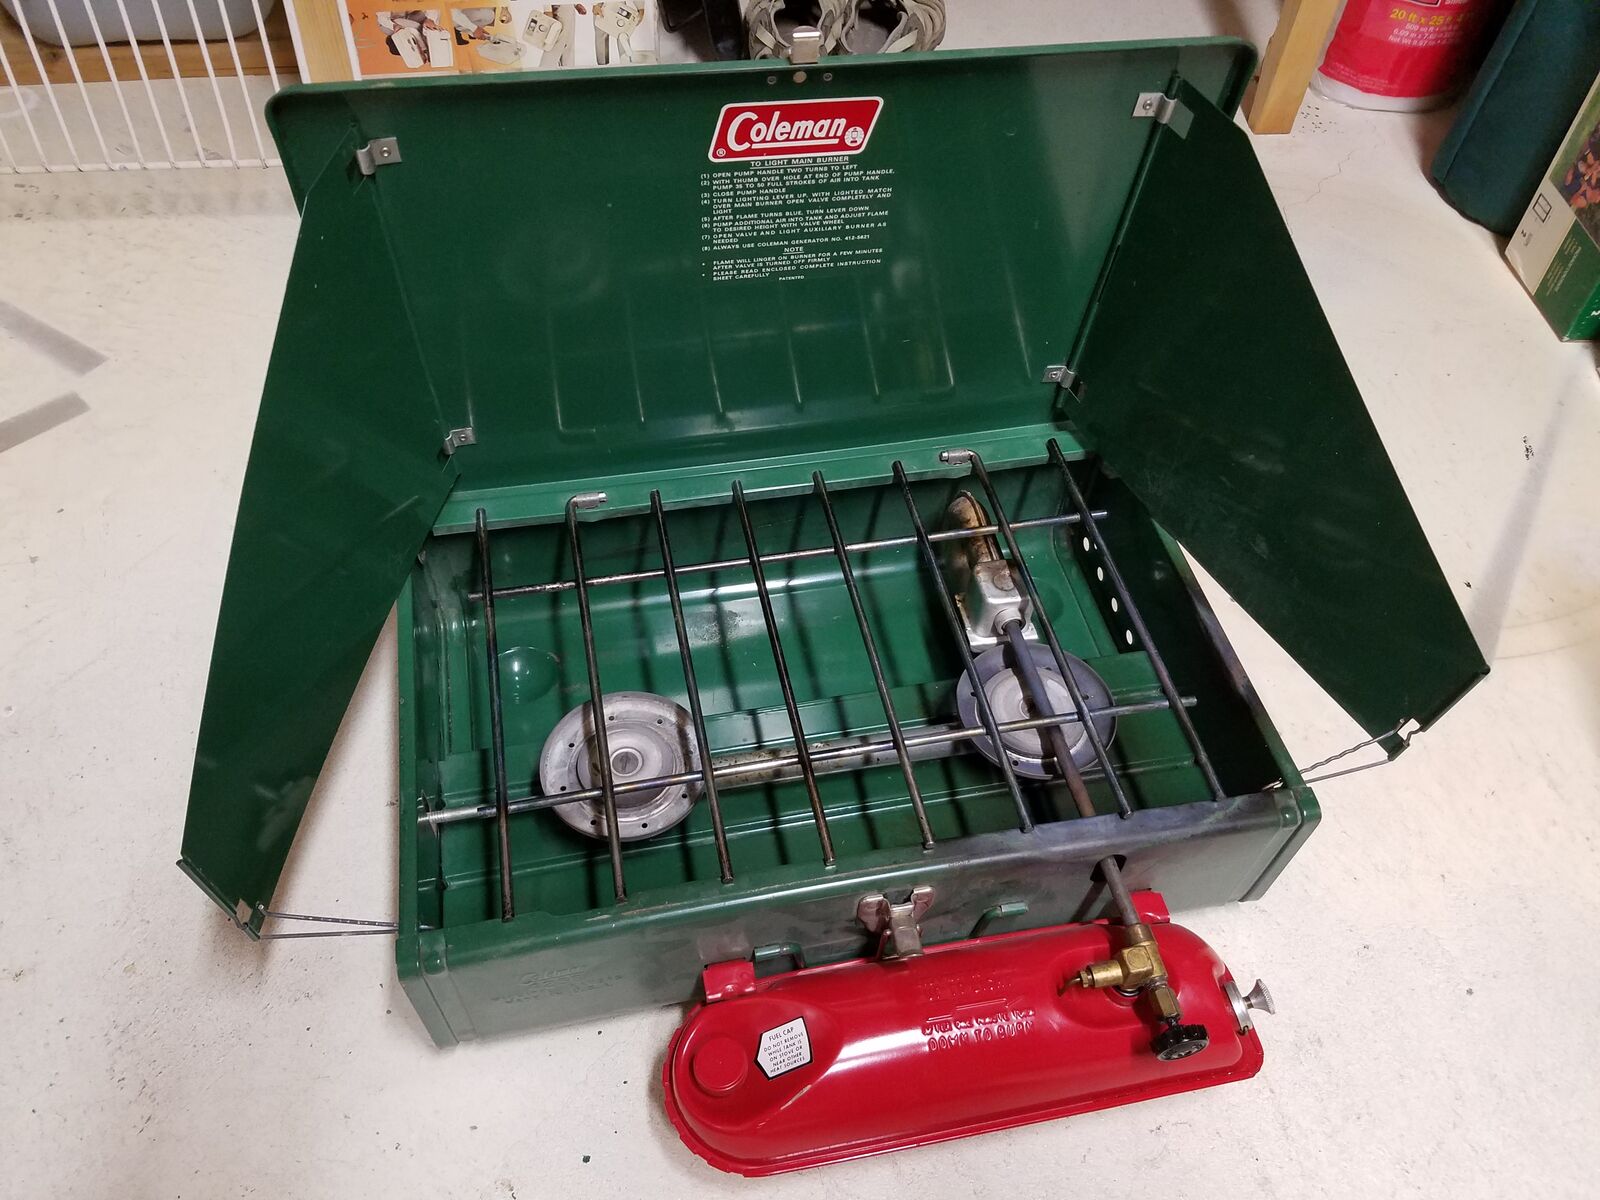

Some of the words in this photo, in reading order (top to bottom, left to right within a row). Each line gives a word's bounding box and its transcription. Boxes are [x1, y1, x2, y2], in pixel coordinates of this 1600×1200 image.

[1390, 8, 1406, 20] 20
[1408, 12, 1418, 22] ft
[1429, 16, 1444, 26] 25
[1388, 34, 1400, 43] Net
[727, 110, 847, 152] Coleman
[832, 194, 873, 202] COMPLETELY
[804, 225, 842, 233] AUXILIARY
[769, 1033, 782, 1042] FUEL
[783, 1027, 794, 1036] CAP
[785, 1032, 804, 1044] REMOVE
[768, 1048, 782, 1056] WHILE
[779, 1050, 794, 1058] STOVE
[773, 1059, 786, 1067] NEAR
[787, 1052, 802, 1061] OTHER
[784, 1057, 805, 1068] SOURCES
